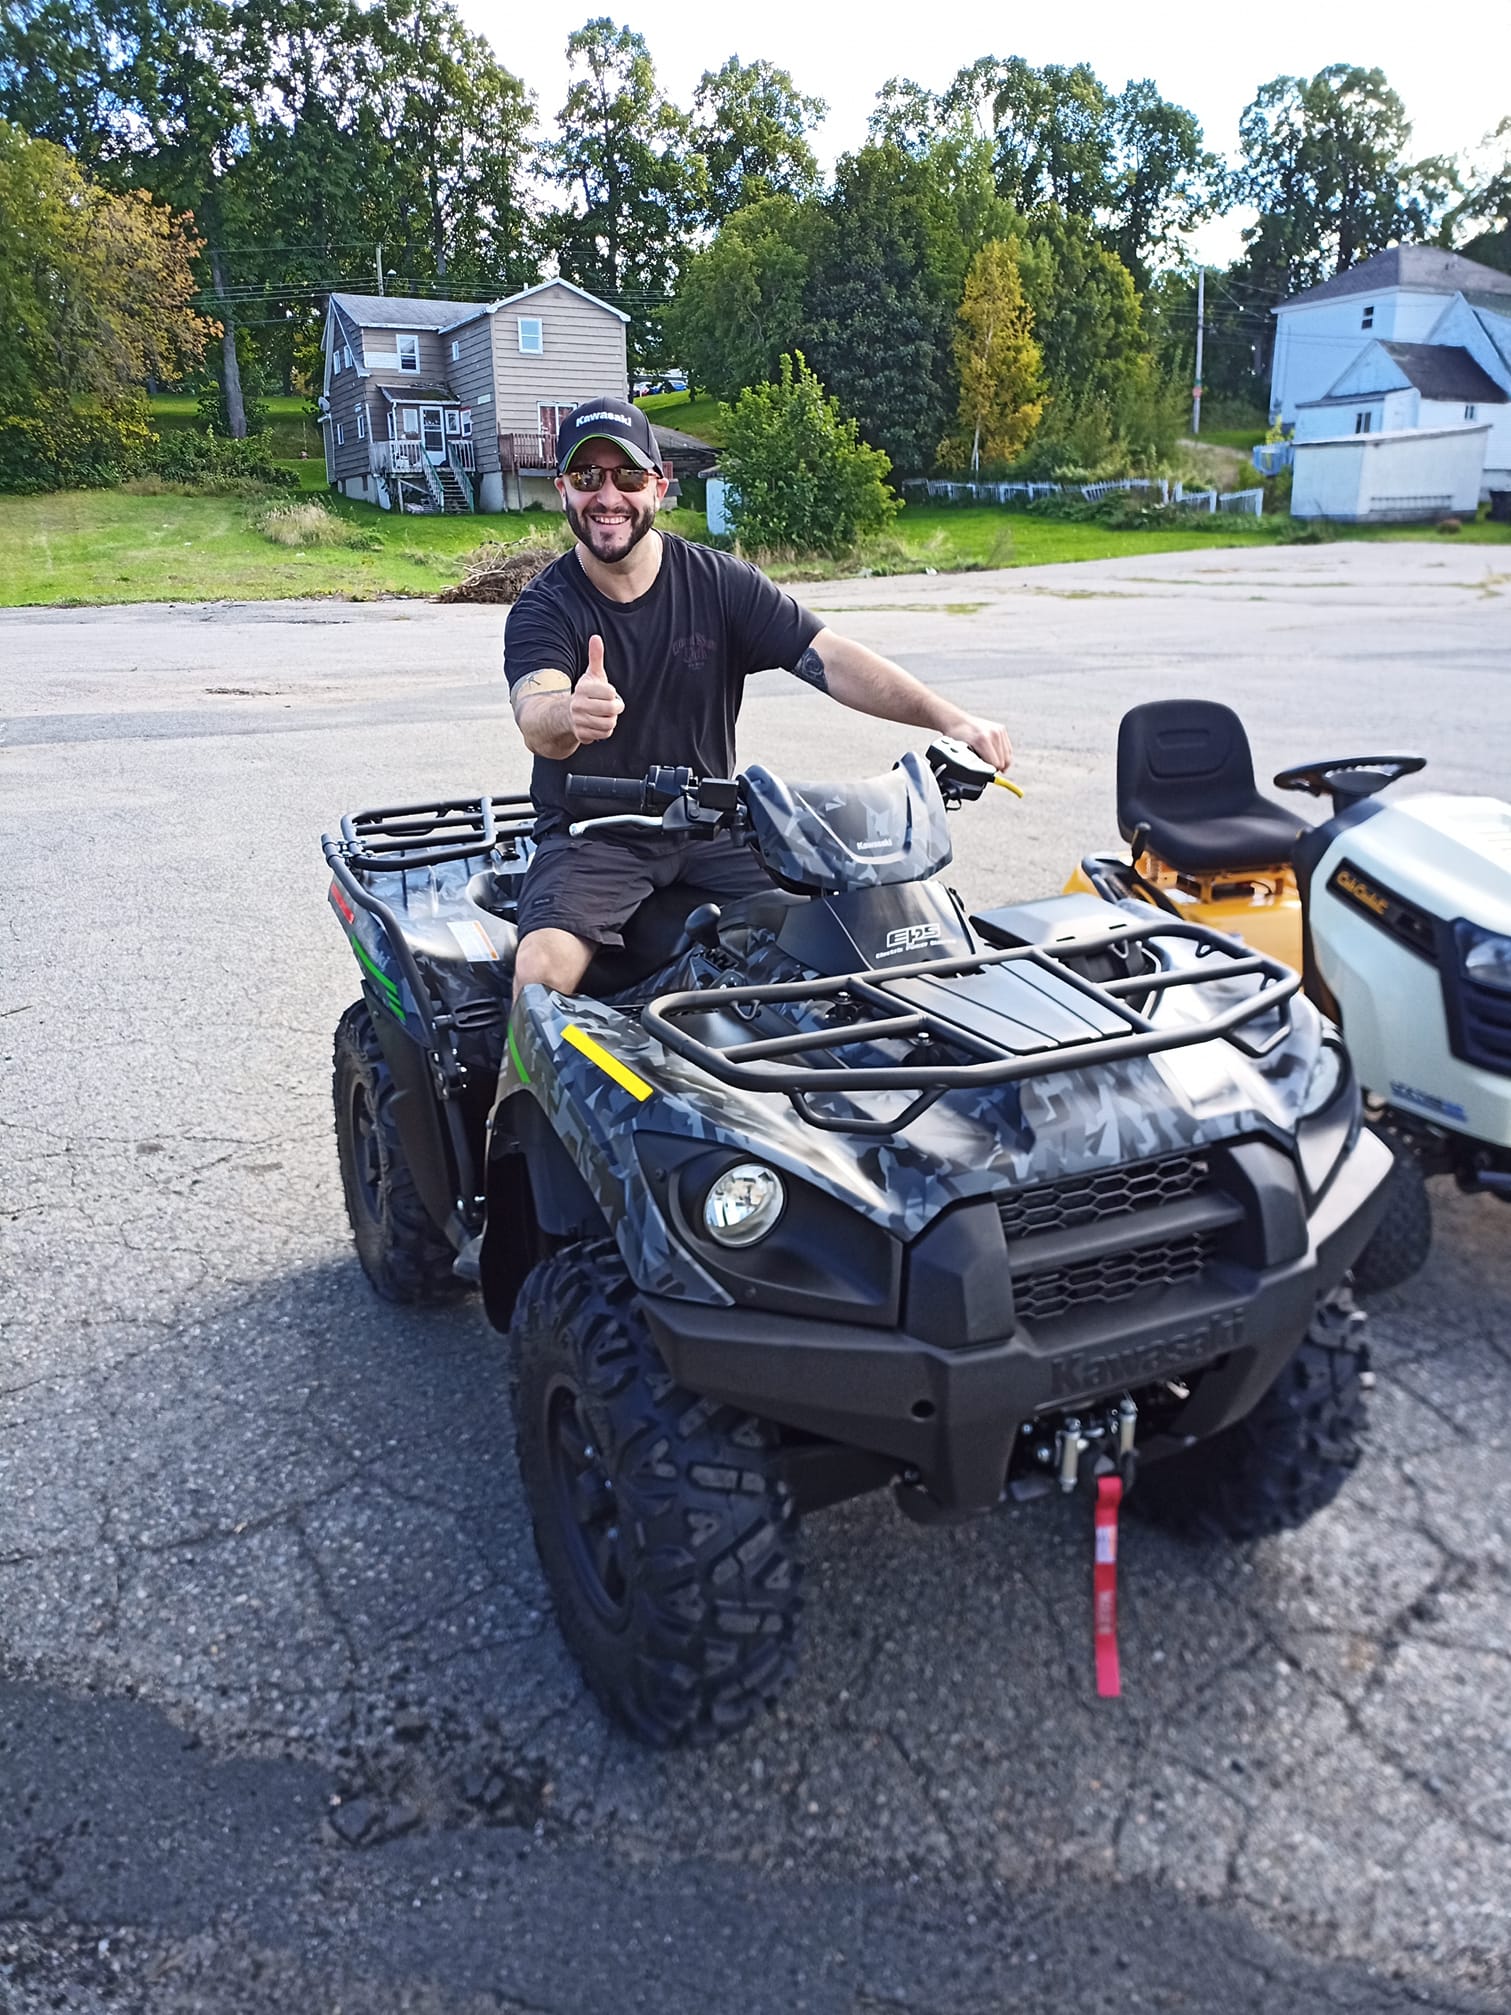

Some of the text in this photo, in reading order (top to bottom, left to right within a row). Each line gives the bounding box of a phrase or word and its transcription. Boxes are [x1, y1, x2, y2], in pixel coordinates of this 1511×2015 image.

[575, 411, 632, 427] Kawasaki
[857, 838, 892, 850] Kawasaki
[887, 923, 941, 947] EPS
[1050, 1305, 1246, 1398] Kawasaki
